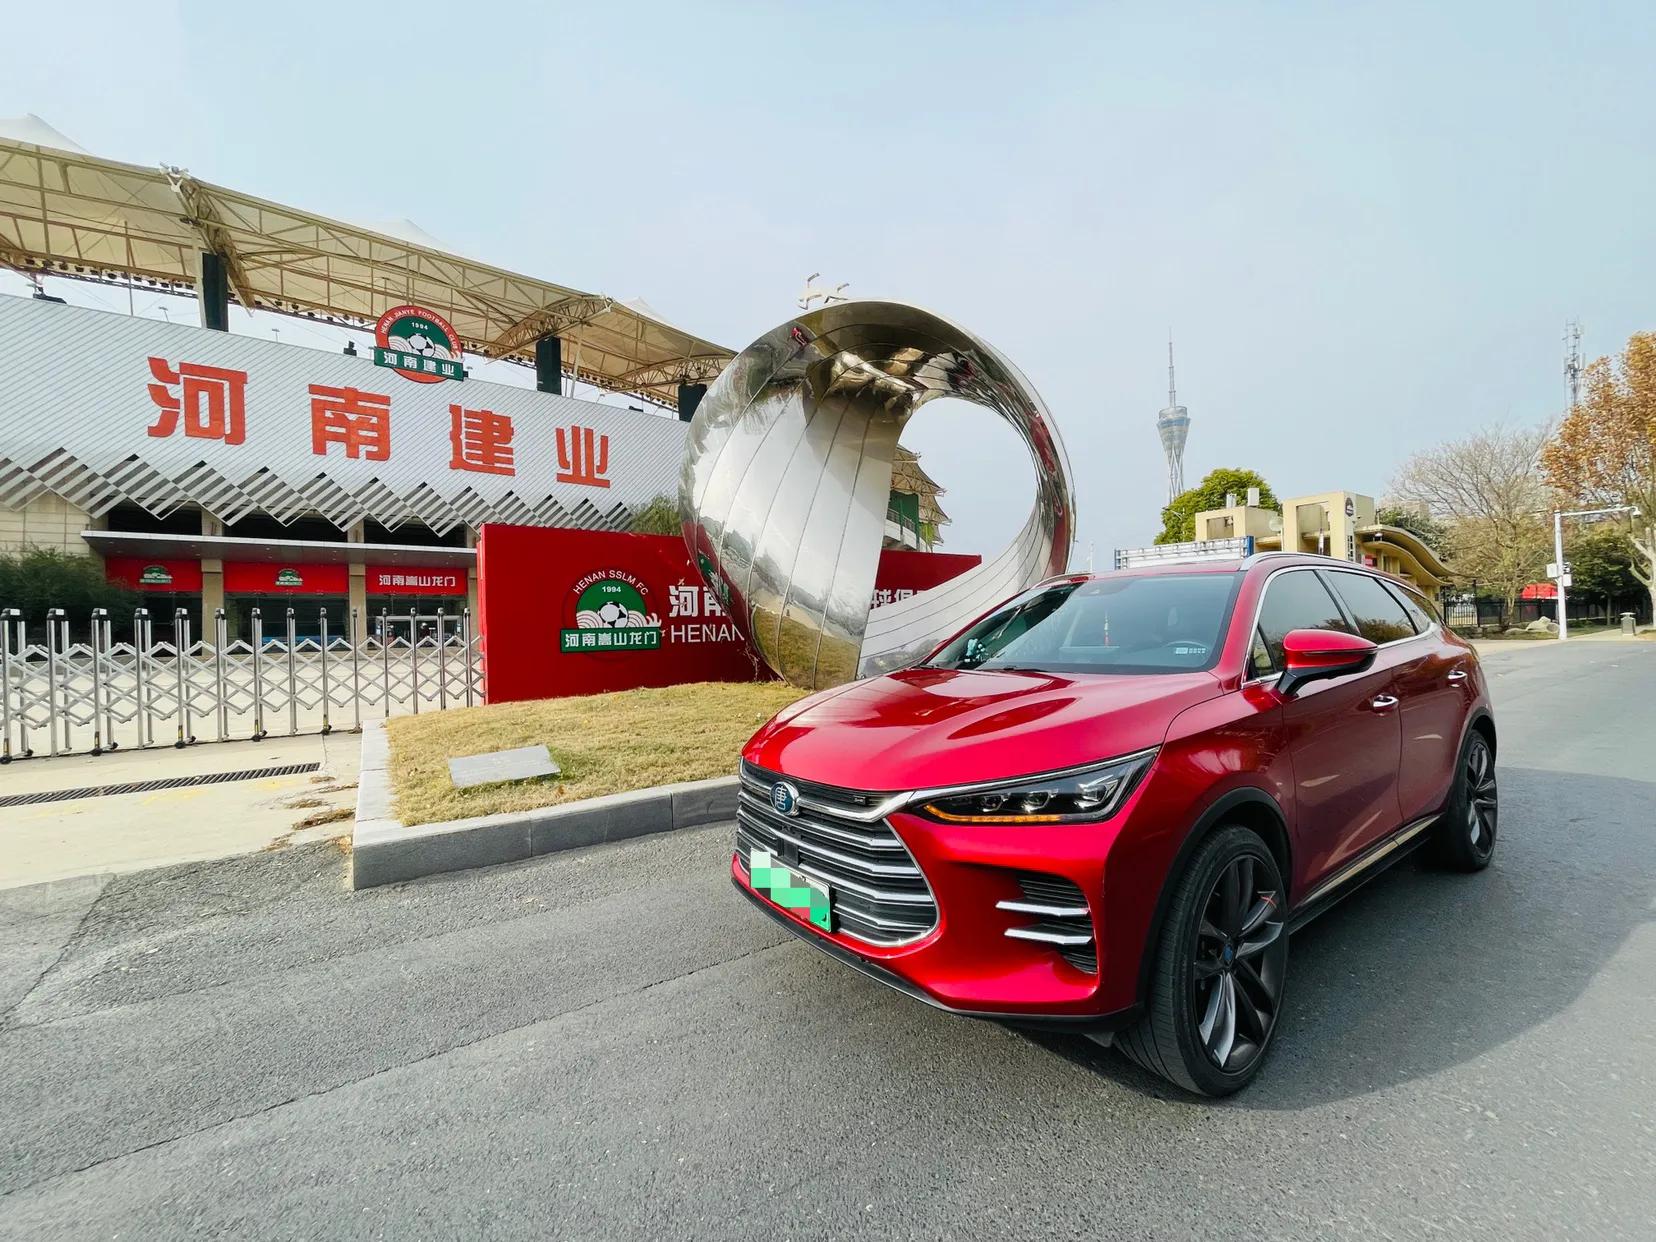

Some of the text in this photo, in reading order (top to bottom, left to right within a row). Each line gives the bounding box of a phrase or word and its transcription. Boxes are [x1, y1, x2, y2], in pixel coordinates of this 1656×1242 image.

[411, 322, 429, 330] 1994
[383, 351, 455, 376] 河南建业
[147, 356, 611, 489] 河南建业
[379, 574, 456, 587] 河南嵩山龙门
[573, 569, 649, 595] HENAN SSLM FC
[565, 631, 657, 648] 河南嵩山龙门
[671, 623, 745, 643] HENAN
